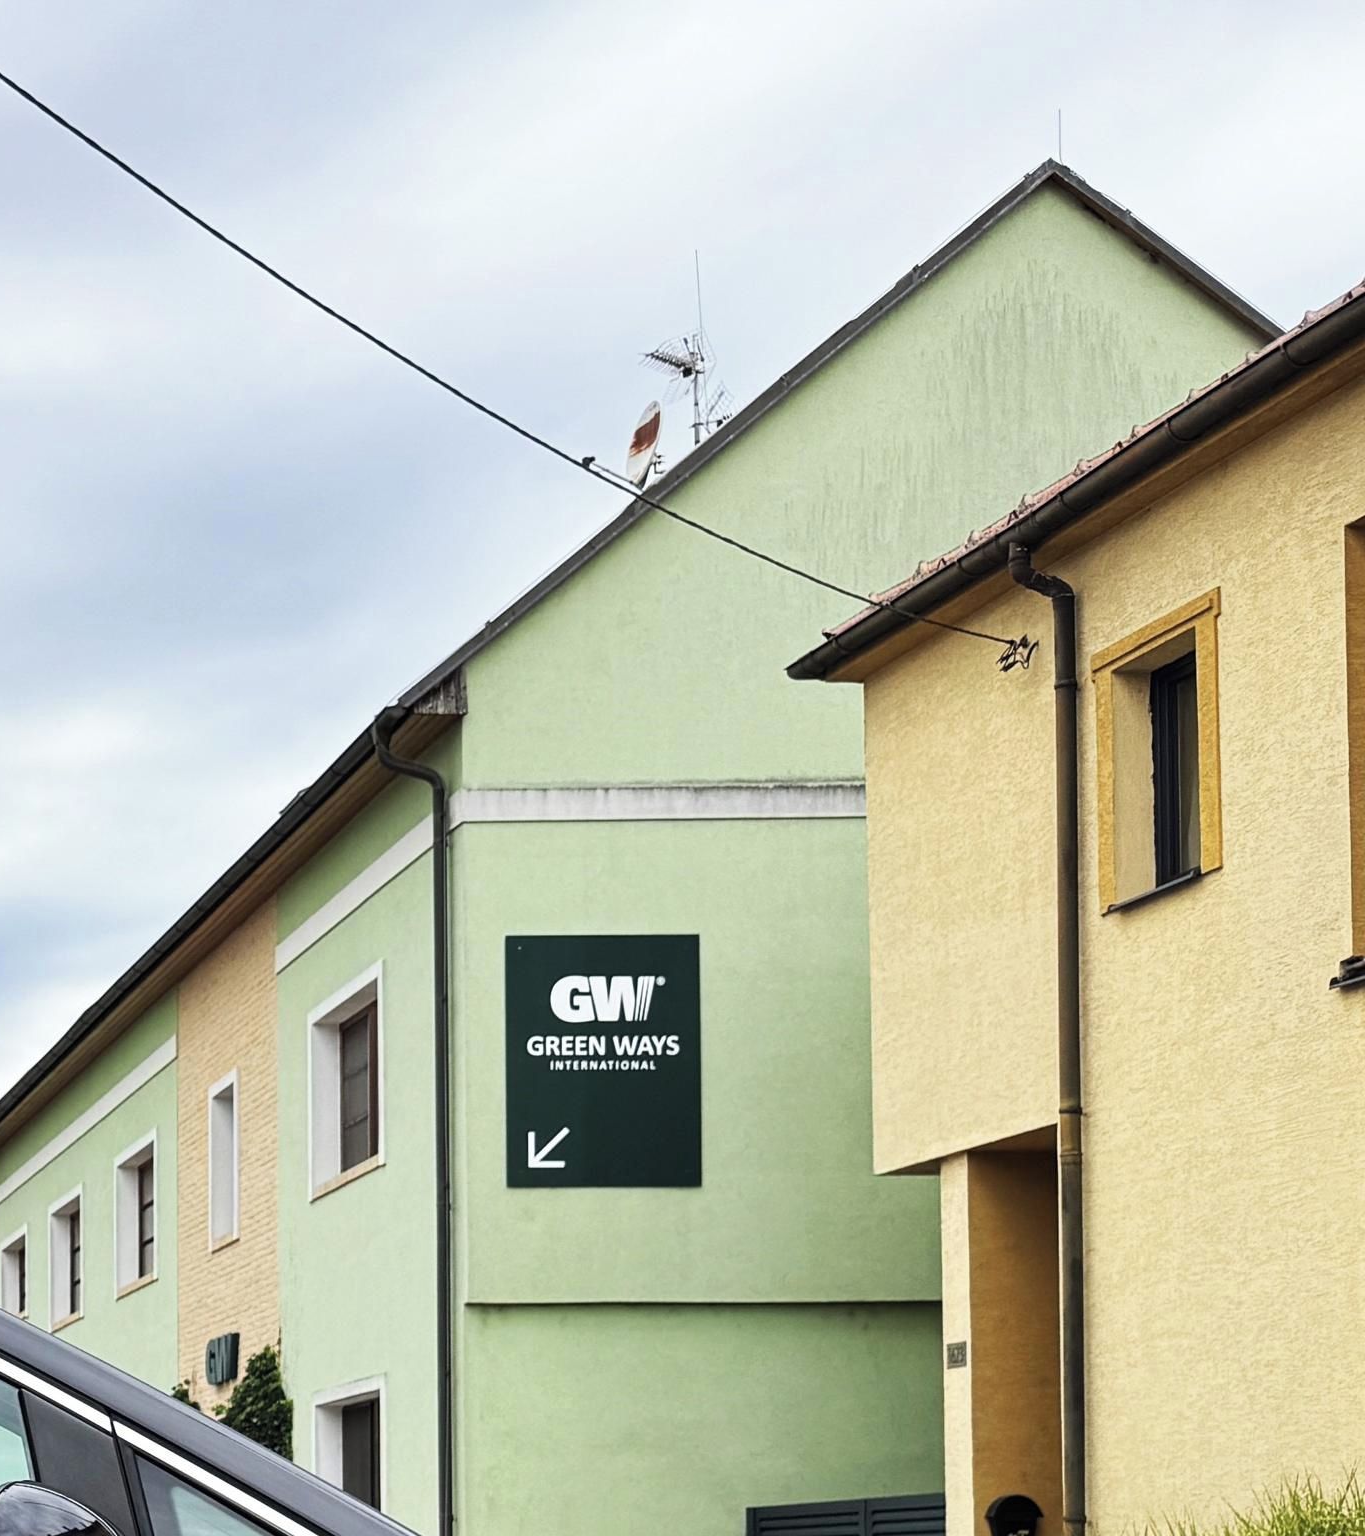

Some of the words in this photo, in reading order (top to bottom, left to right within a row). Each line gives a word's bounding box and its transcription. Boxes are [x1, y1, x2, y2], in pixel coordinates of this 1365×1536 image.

[526, 1035, 606, 1056] GREEN
[613, 1035, 680, 1056] WAYS
[550, 1060, 656, 1071] INTERNATIONAL
[205, 1333, 240, 1386] GW
